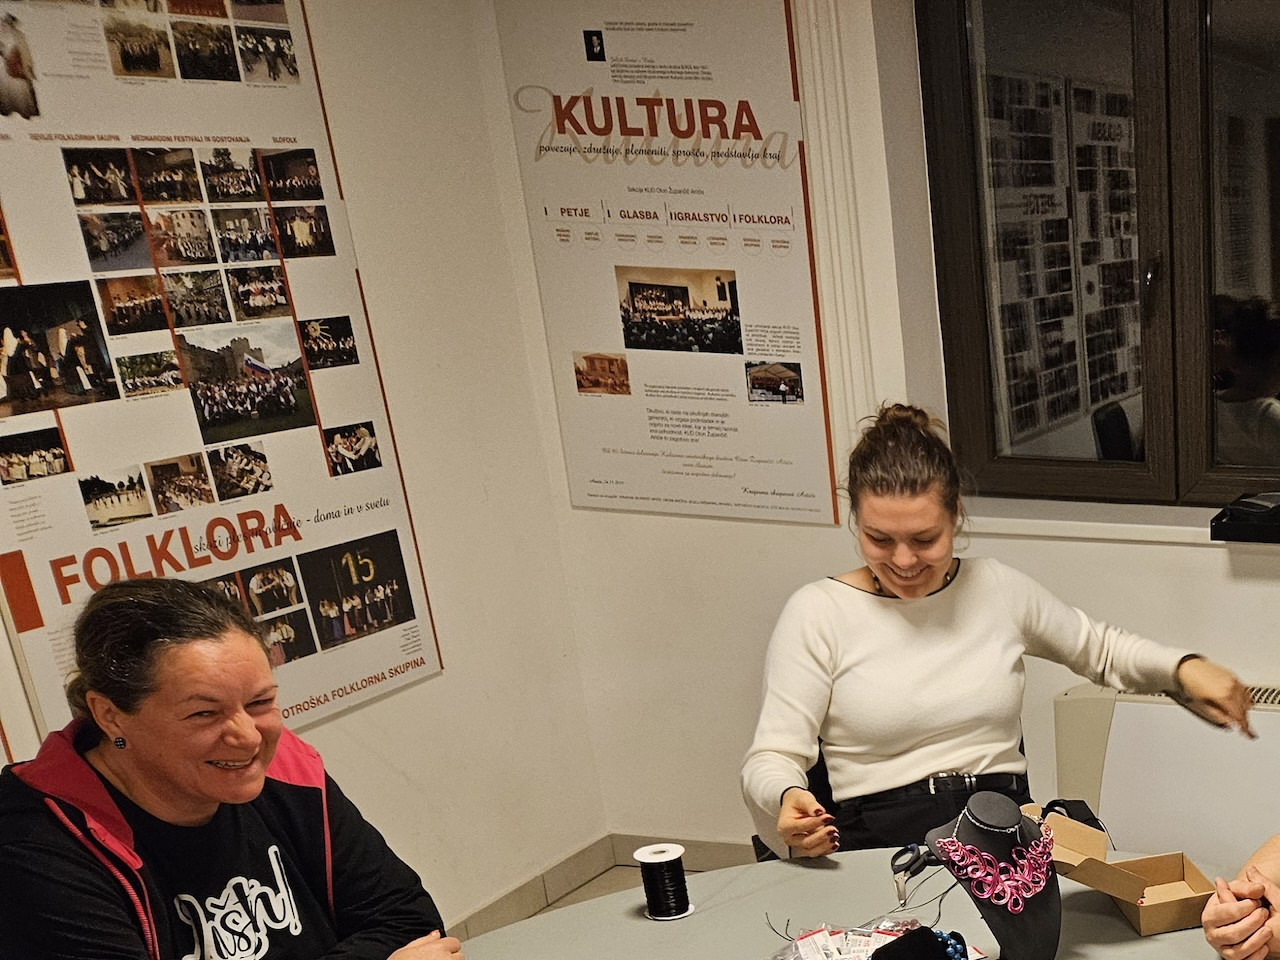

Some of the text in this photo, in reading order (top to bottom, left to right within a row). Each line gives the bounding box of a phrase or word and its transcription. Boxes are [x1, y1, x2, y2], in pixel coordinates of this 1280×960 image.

[553, 95, 763, 140] KULTURA
[762, 152, 781, 162] kraj
[560, 207, 590, 218] PETJE
[619, 209, 659, 220] GLASBA
[739, 214, 791, 225] FOLKLORA
[314, 508, 341, 523] doma
[344, 504, 354, 516] in
[365, 497, 390, 511] svetu
[49, 503, 303, 606] FOLKLORA
[341, 551, 375, 586] 15
[282, 656, 426, 719] OTROŠKA FOLKLORNA SKUPINA
